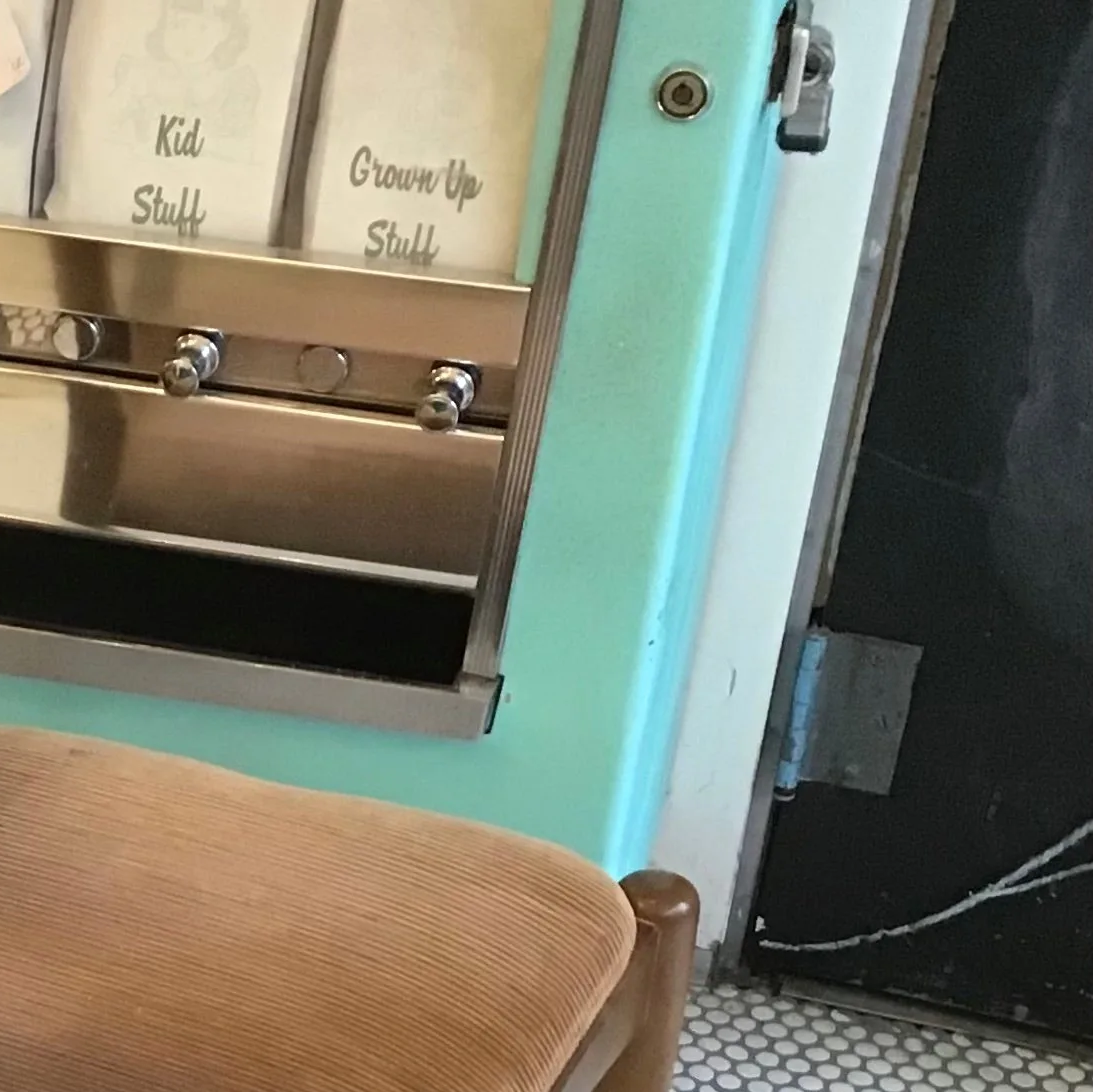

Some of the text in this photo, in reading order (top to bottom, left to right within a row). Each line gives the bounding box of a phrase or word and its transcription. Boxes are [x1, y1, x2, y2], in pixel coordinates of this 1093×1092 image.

[155, 114, 205, 159] Kid
[349, 145, 483, 213] Grown Up
[131, 184, 207, 238] Stuff
[364, 219, 441, 267] Stuff
